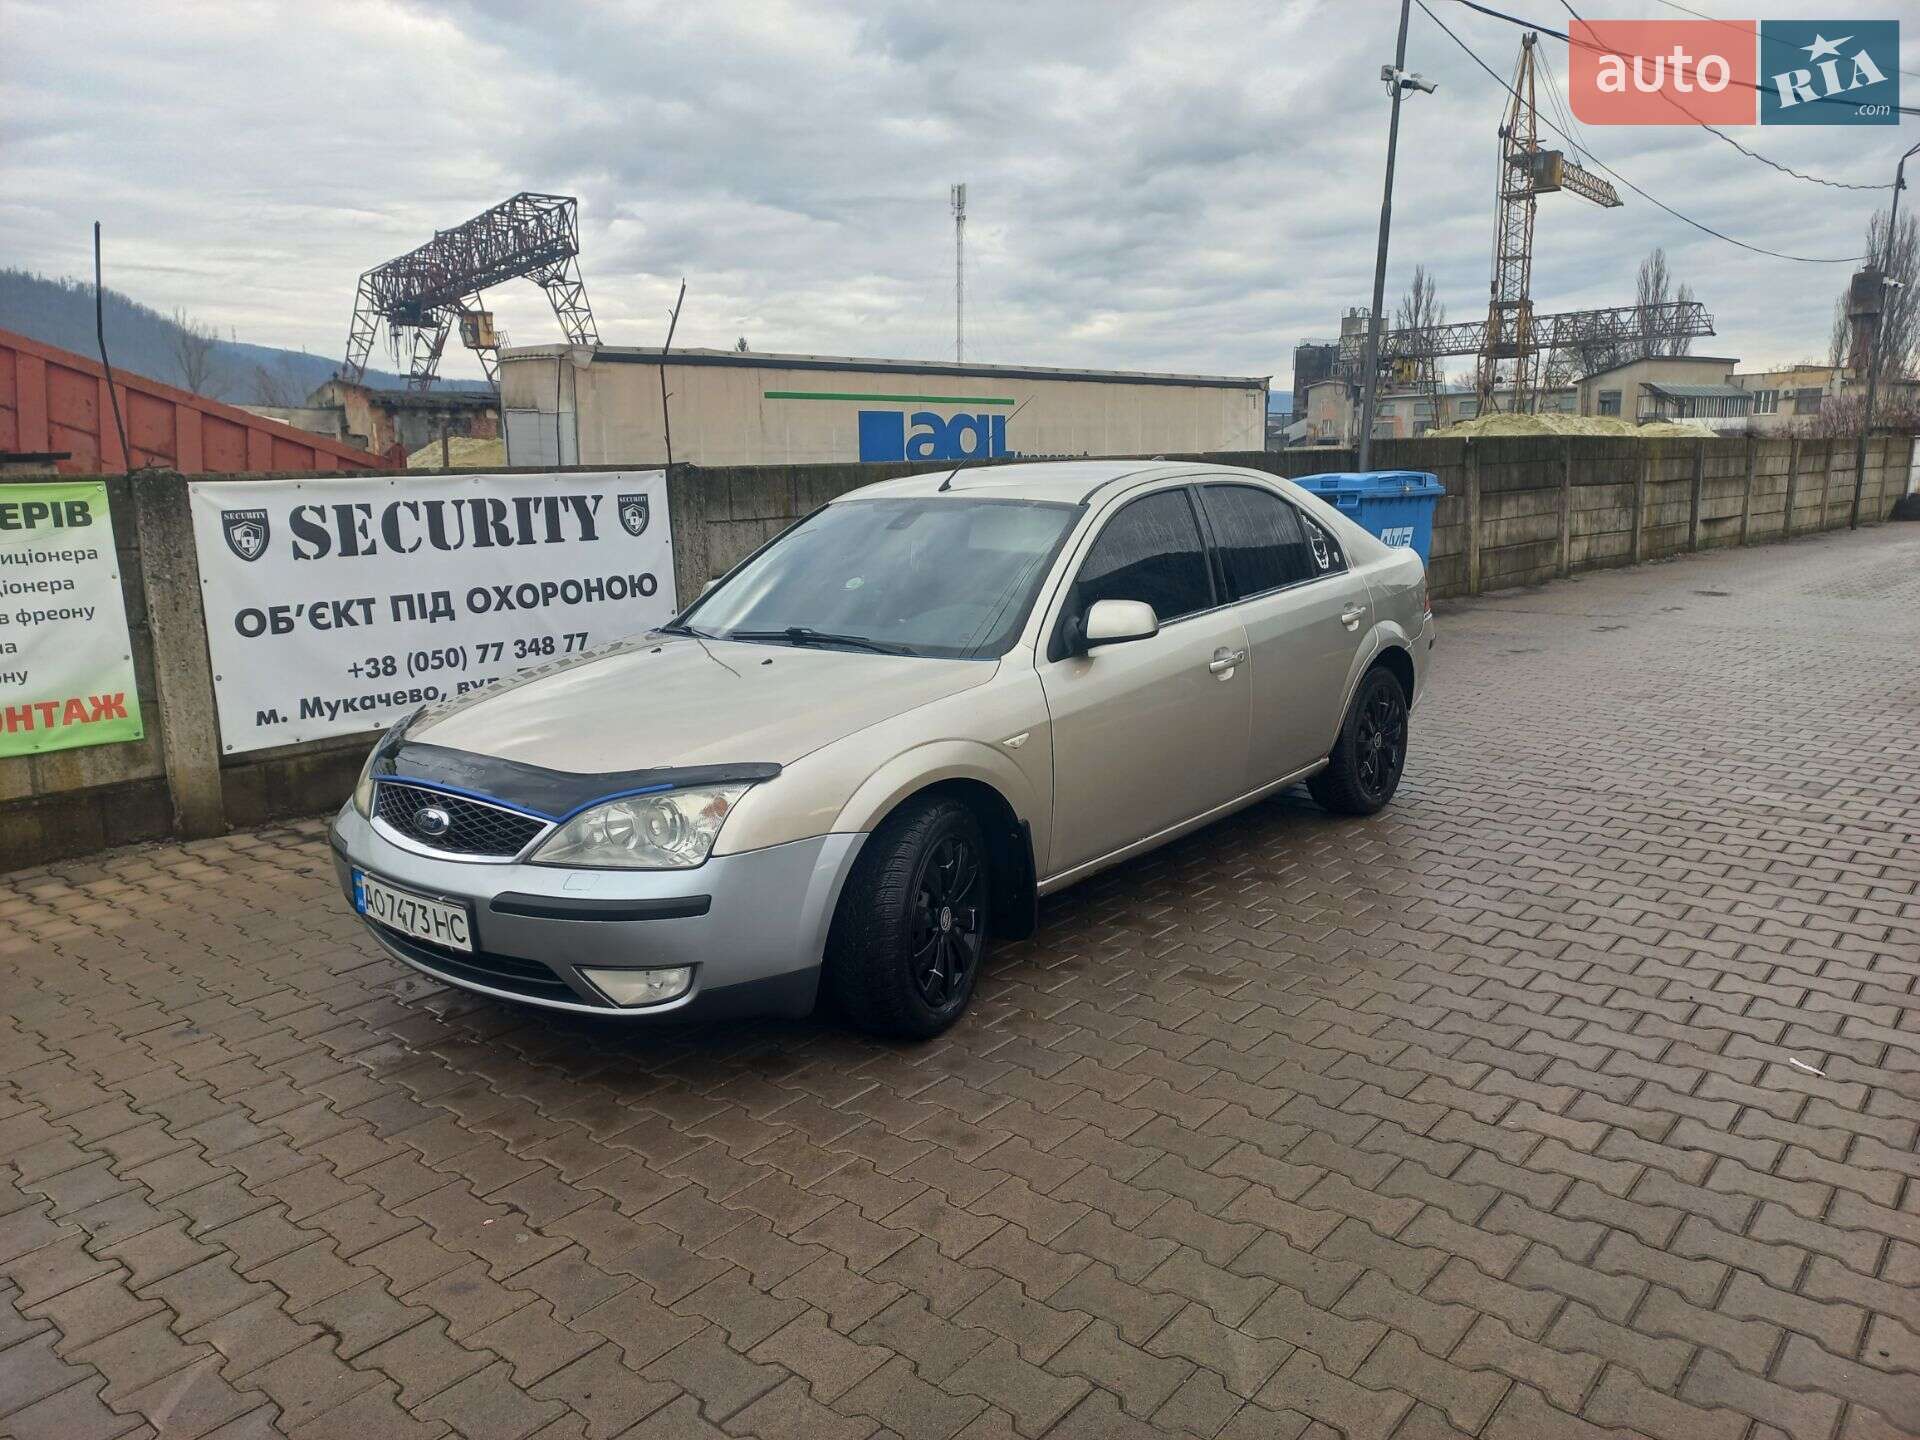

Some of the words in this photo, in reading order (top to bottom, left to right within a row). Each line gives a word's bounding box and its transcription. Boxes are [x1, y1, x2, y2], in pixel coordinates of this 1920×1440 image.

[223, 511, 266, 520] SECURITY
[288, 494, 603, 561] SECURITY
[0, 548, 99, 566] иціонера
[0, 578, 75, 597] іонера
[390, 590, 456, 623] ПІД
[466, 572, 658, 614] ОХОРОНОЮ
[15, 605, 96, 626] фреону
[347, 655, 398, 680] +38
[406, 645, 468, 677] (050)
[475, 641, 504, 664] 77
[514, 636, 555, 660] 348
[562, 632, 589, 653] 77
[0, 669, 29, 684] ну
[0, 692, 128, 733] НТАЖ
[255, 708, 288, 727] м.
[300, 684, 448, 722] Мукачево,
